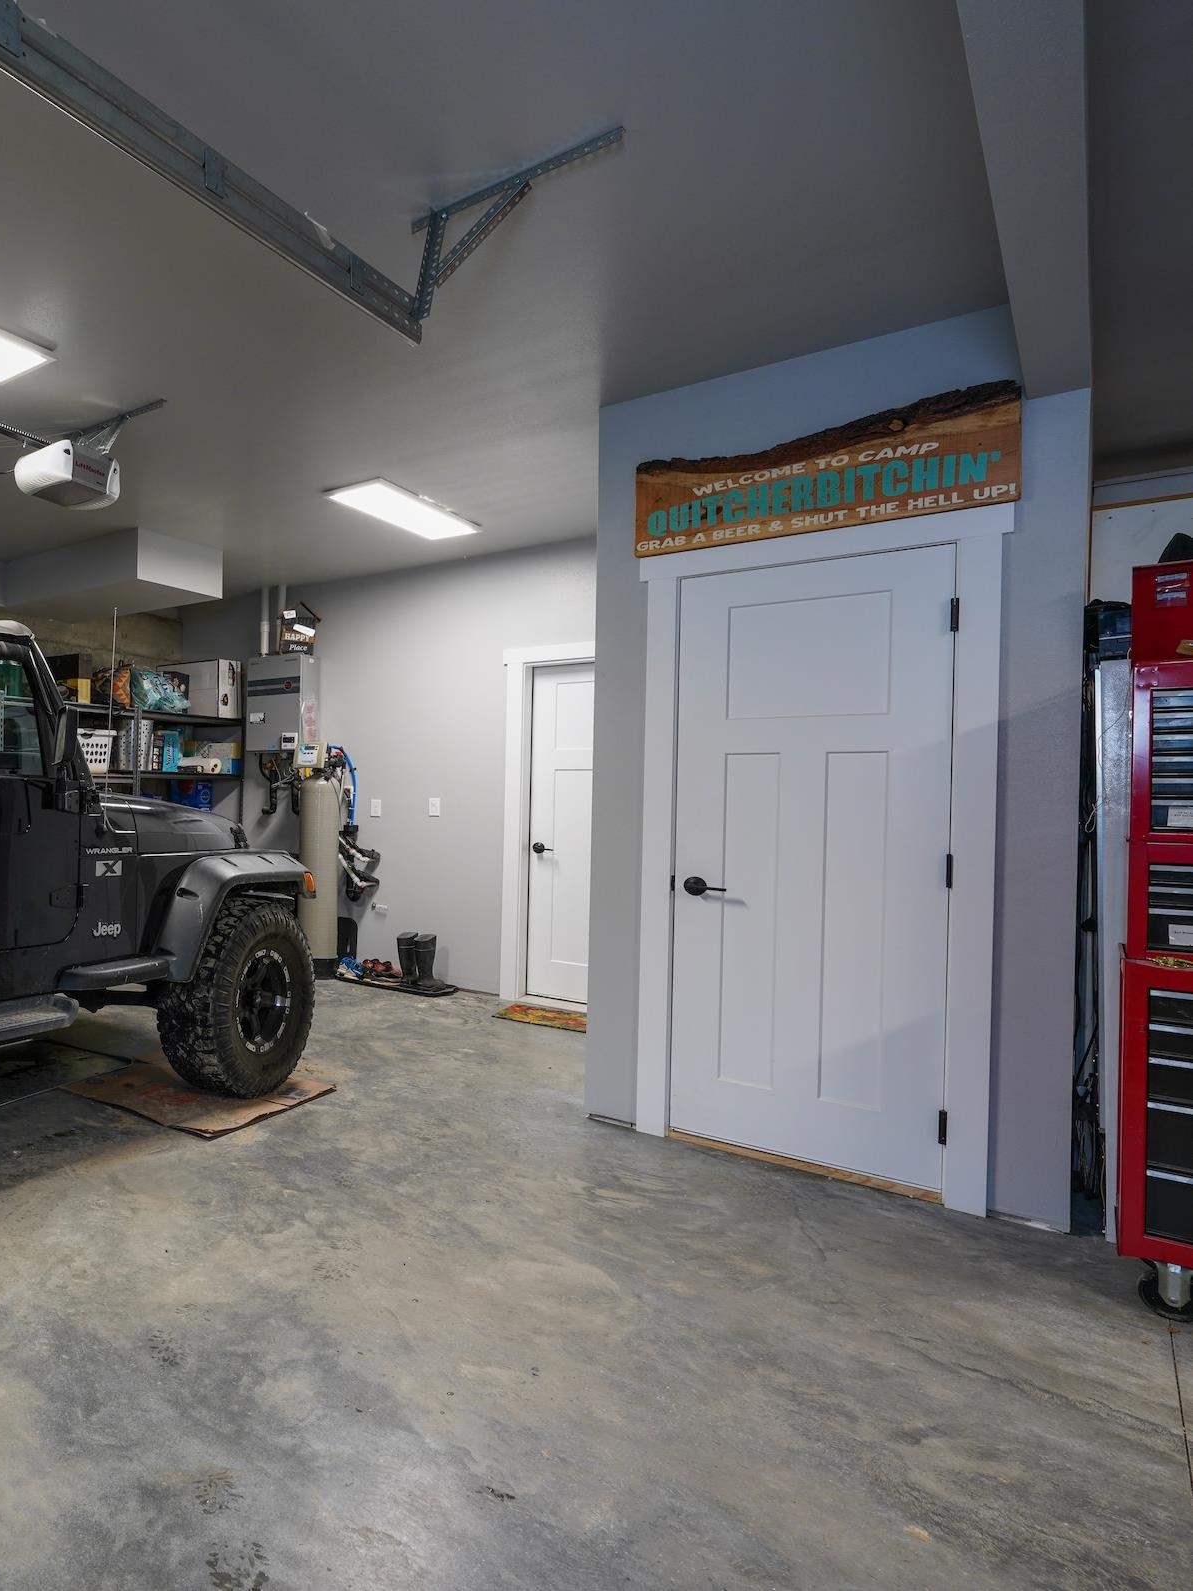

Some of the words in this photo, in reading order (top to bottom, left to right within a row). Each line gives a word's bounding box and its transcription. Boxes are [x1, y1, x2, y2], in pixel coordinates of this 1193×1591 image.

[692, 462, 806, 497] WELCOME
[814, 455, 849, 470] TO
[858, 442, 940, 463] CAMP
[647, 451, 1002, 537] QUITCHERBITCHIN'
[636, 535, 686, 552] GRAB
[692, 532, 707, 544] A
[712, 524, 760, 541] BEER
[768, 520, 783, 532] &
[791, 509, 848, 529] SHUT
[856, 501, 900, 518] THE
[907, 491, 965, 511] HELL
[972, 482, 1017, 500] UP!
[284, 632, 310, 642] HAPPY
[288, 643, 308, 652] Place
[85, 846, 133, 855] WRANGLER
[92, 921, 122, 938] Jeep
